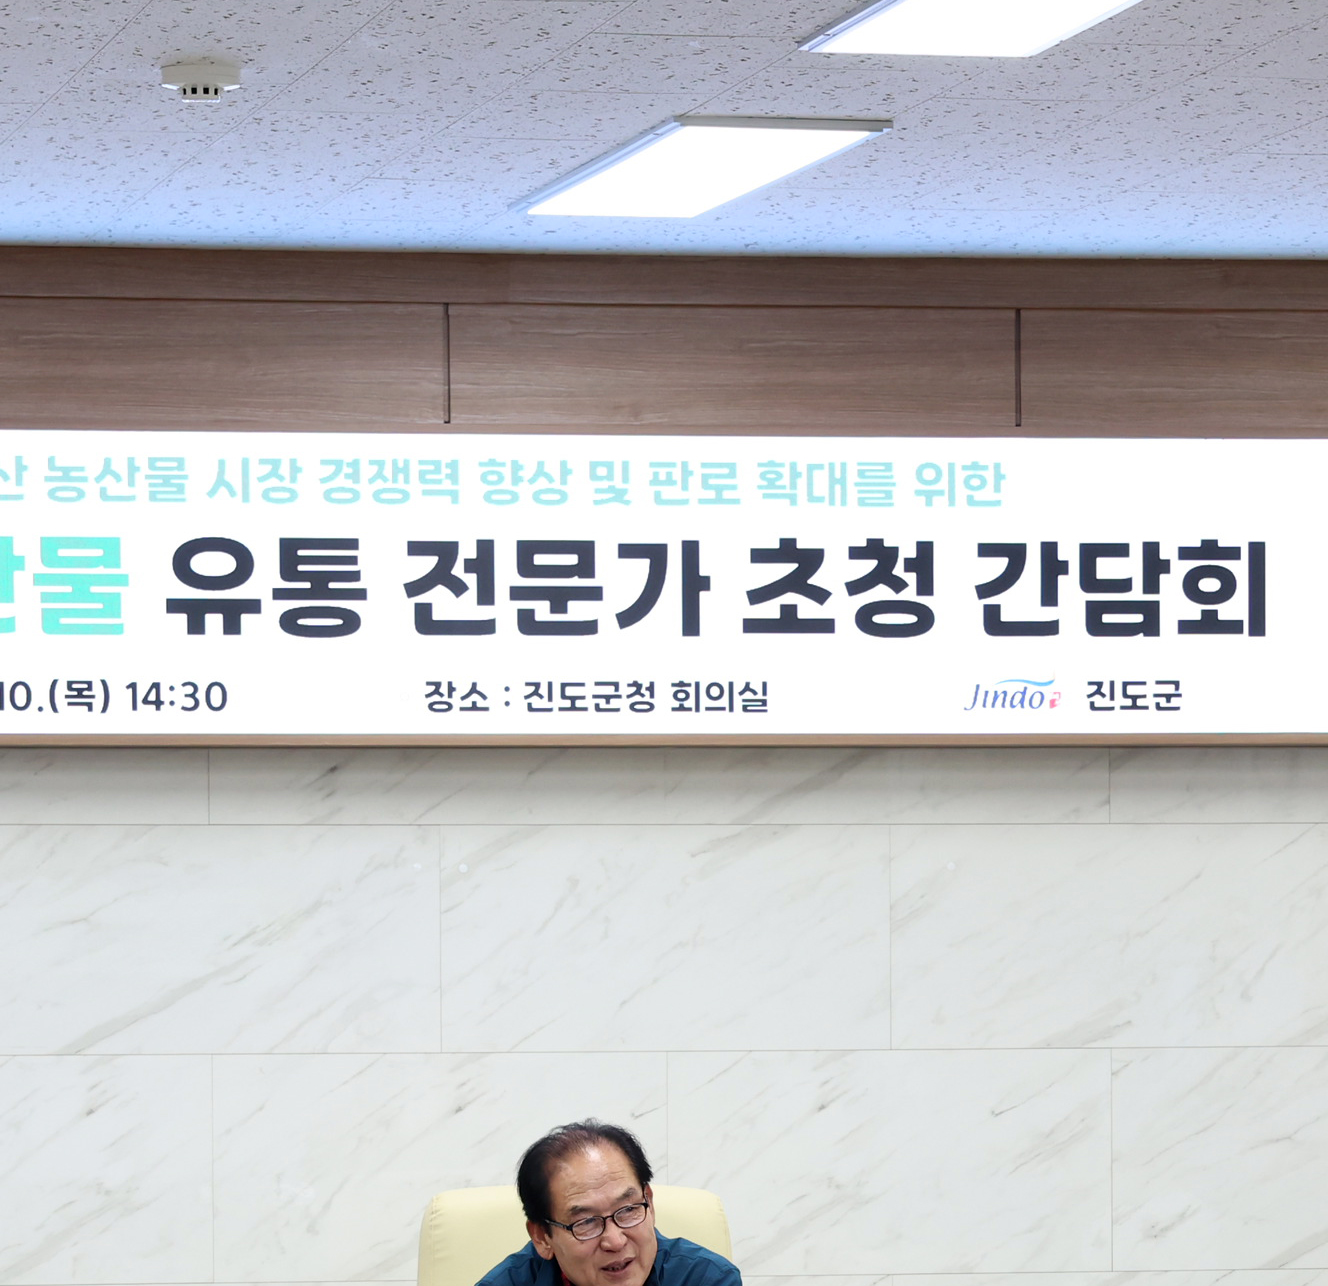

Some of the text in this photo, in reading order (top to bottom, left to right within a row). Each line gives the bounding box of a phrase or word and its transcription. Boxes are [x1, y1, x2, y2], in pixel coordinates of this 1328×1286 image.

[43, 455, 190, 504] 농산물
[205, 456, 304, 505] 시장
[319, 457, 460, 506] 경쟁력
[477, 458, 574, 507] 향상
[588, 459, 633, 507] 및
[648, 460, 742, 507] 판로
[756, 459, 897, 508] 확대를
[913, 460, 1007, 508] 위한
[165, 536, 368, 639] 유통
[402, 538, 712, 638] 전문가
[742, 537, 936, 639] 초청
[974, 538, 1267, 638] 간담회
[125, 681, 228, 712] 14:30
[424, 680, 490, 713] 장소
[523, 680, 656, 714] 진도군청
[670, 680, 769, 713] 회의실
[963, 683, 1045, 711] Jindo
[1086, 679, 1183, 712] 진도군
